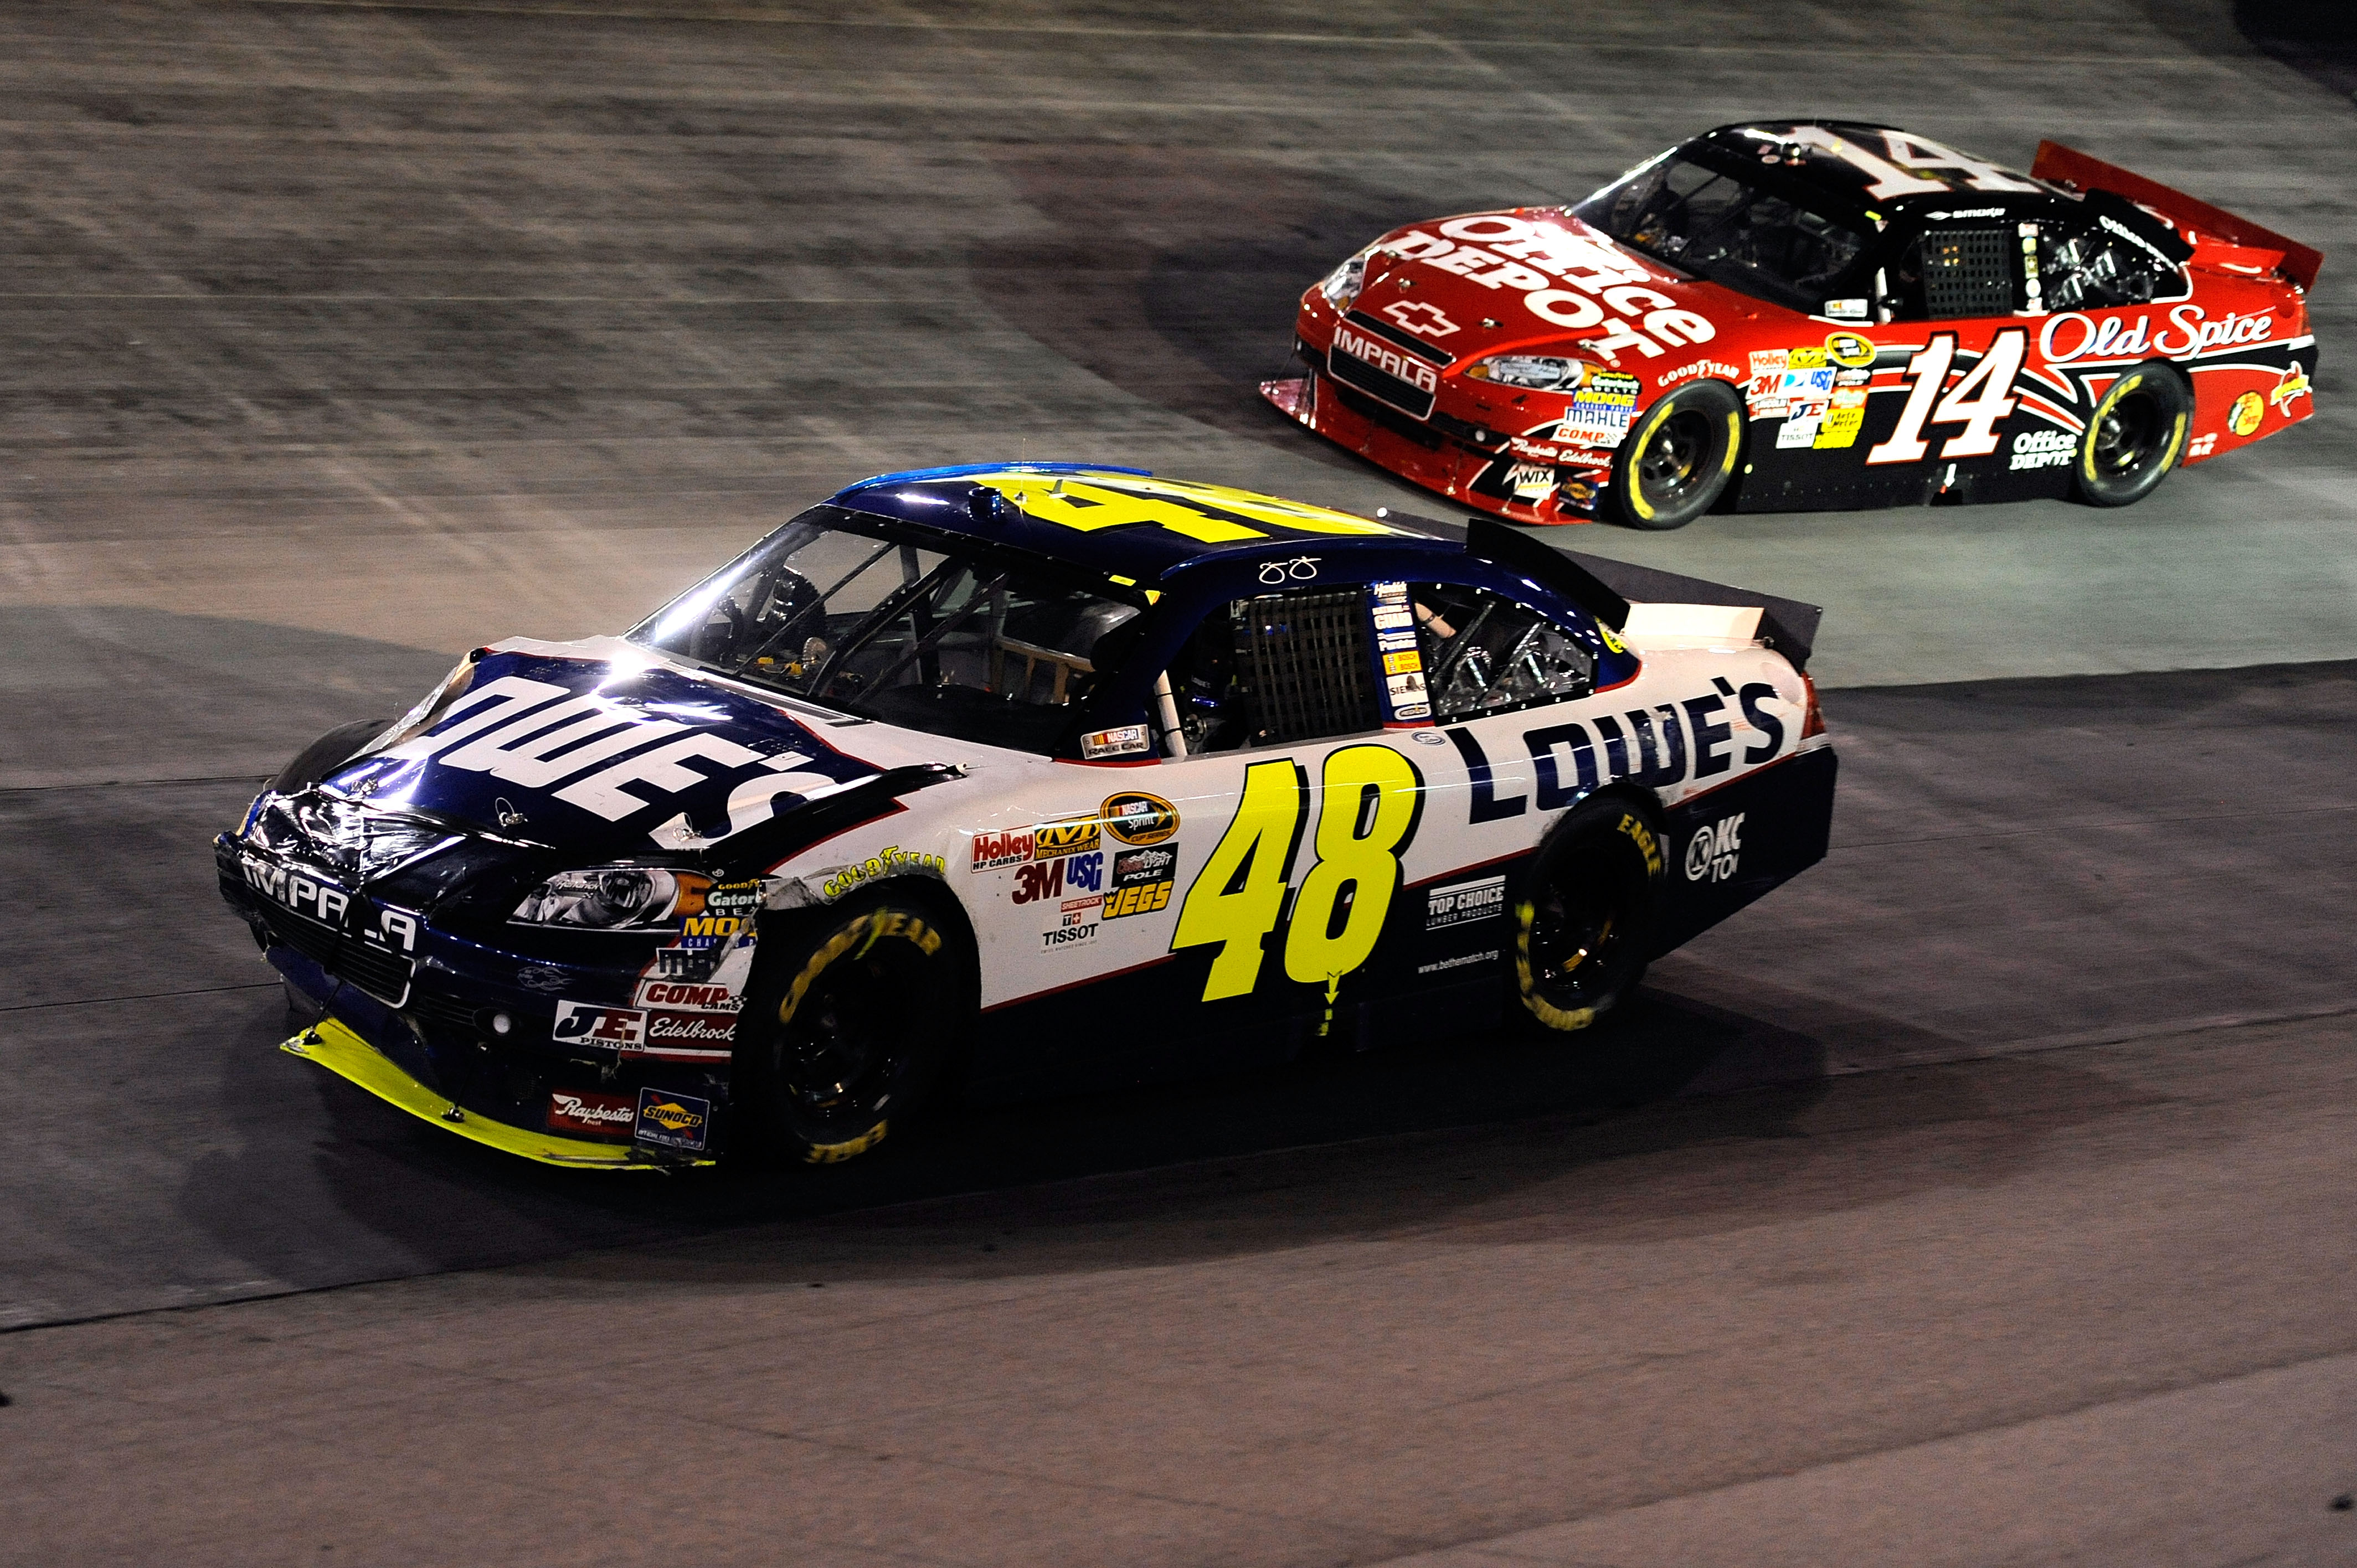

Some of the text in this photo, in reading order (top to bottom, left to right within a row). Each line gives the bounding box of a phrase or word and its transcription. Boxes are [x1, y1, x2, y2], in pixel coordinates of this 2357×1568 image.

[1788, 126, 2047, 201] 14
[1439, 216, 1716, 347] Office
[1381, 230, 1665, 361] DEPOT
[2039, 305, 2272, 363] Old Spice
[1333, 326, 1437, 393] IMPALA
[1658, 359, 1740, 386] GOODYEAR
[1811, 370, 1832, 390] USG
[1751, 374, 1782, 395] 3M
[1574, 391, 1636, 407] MOOG
[1866, 327, 2027, 465] 14
[1567, 409, 1628, 427] MAHLE
[1791, 403, 1825, 420] JE
[1558, 428, 1605, 441] COMP
[2014, 431, 2077, 453] Office
[2010, 451, 2071, 471] DEPOT
[1520, 471, 1550, 483] WIX
[1108, 729, 1139, 742] NASCAR
[1088, 741, 1144, 756] RACE CAR
[1444, 677, 1785, 825] LOWE'S
[1122, 801, 1148, 815] NASCAR
[1128, 817, 1155, 831] Sprint
[974, 833, 1033, 862] Holley
[1036, 839, 1100, 859] MECHANIX WEAR
[973, 855, 1022, 870] HP CARBS
[1067, 852, 1104, 892] USG
[1169, 744, 1424, 1002] 48
[1012, 858, 1066, 905] 3M
[1123, 869, 1164, 881] POLE
[243, 863, 416, 952] IMPAA
[1103, 880, 1174, 918] JEGS
[1428, 886, 1505, 915] TOP CHOICE
[1426, 904, 1503, 926] LUMBER PRODUCTS
[683, 917, 756, 937] MOO
[1043, 923, 1099, 946] TISSOT
[646, 984, 729, 1006] COMP
[701, 1000, 741, 1012] CAMS
[554, 1006, 642, 1041] JE
[650, 1017, 736, 1044] Edelbrock
[580, 1037, 642, 1051] PISTONS
[553, 1094, 635, 1123] Raybestos
[645, 1106, 701, 1127] SUNOCO
